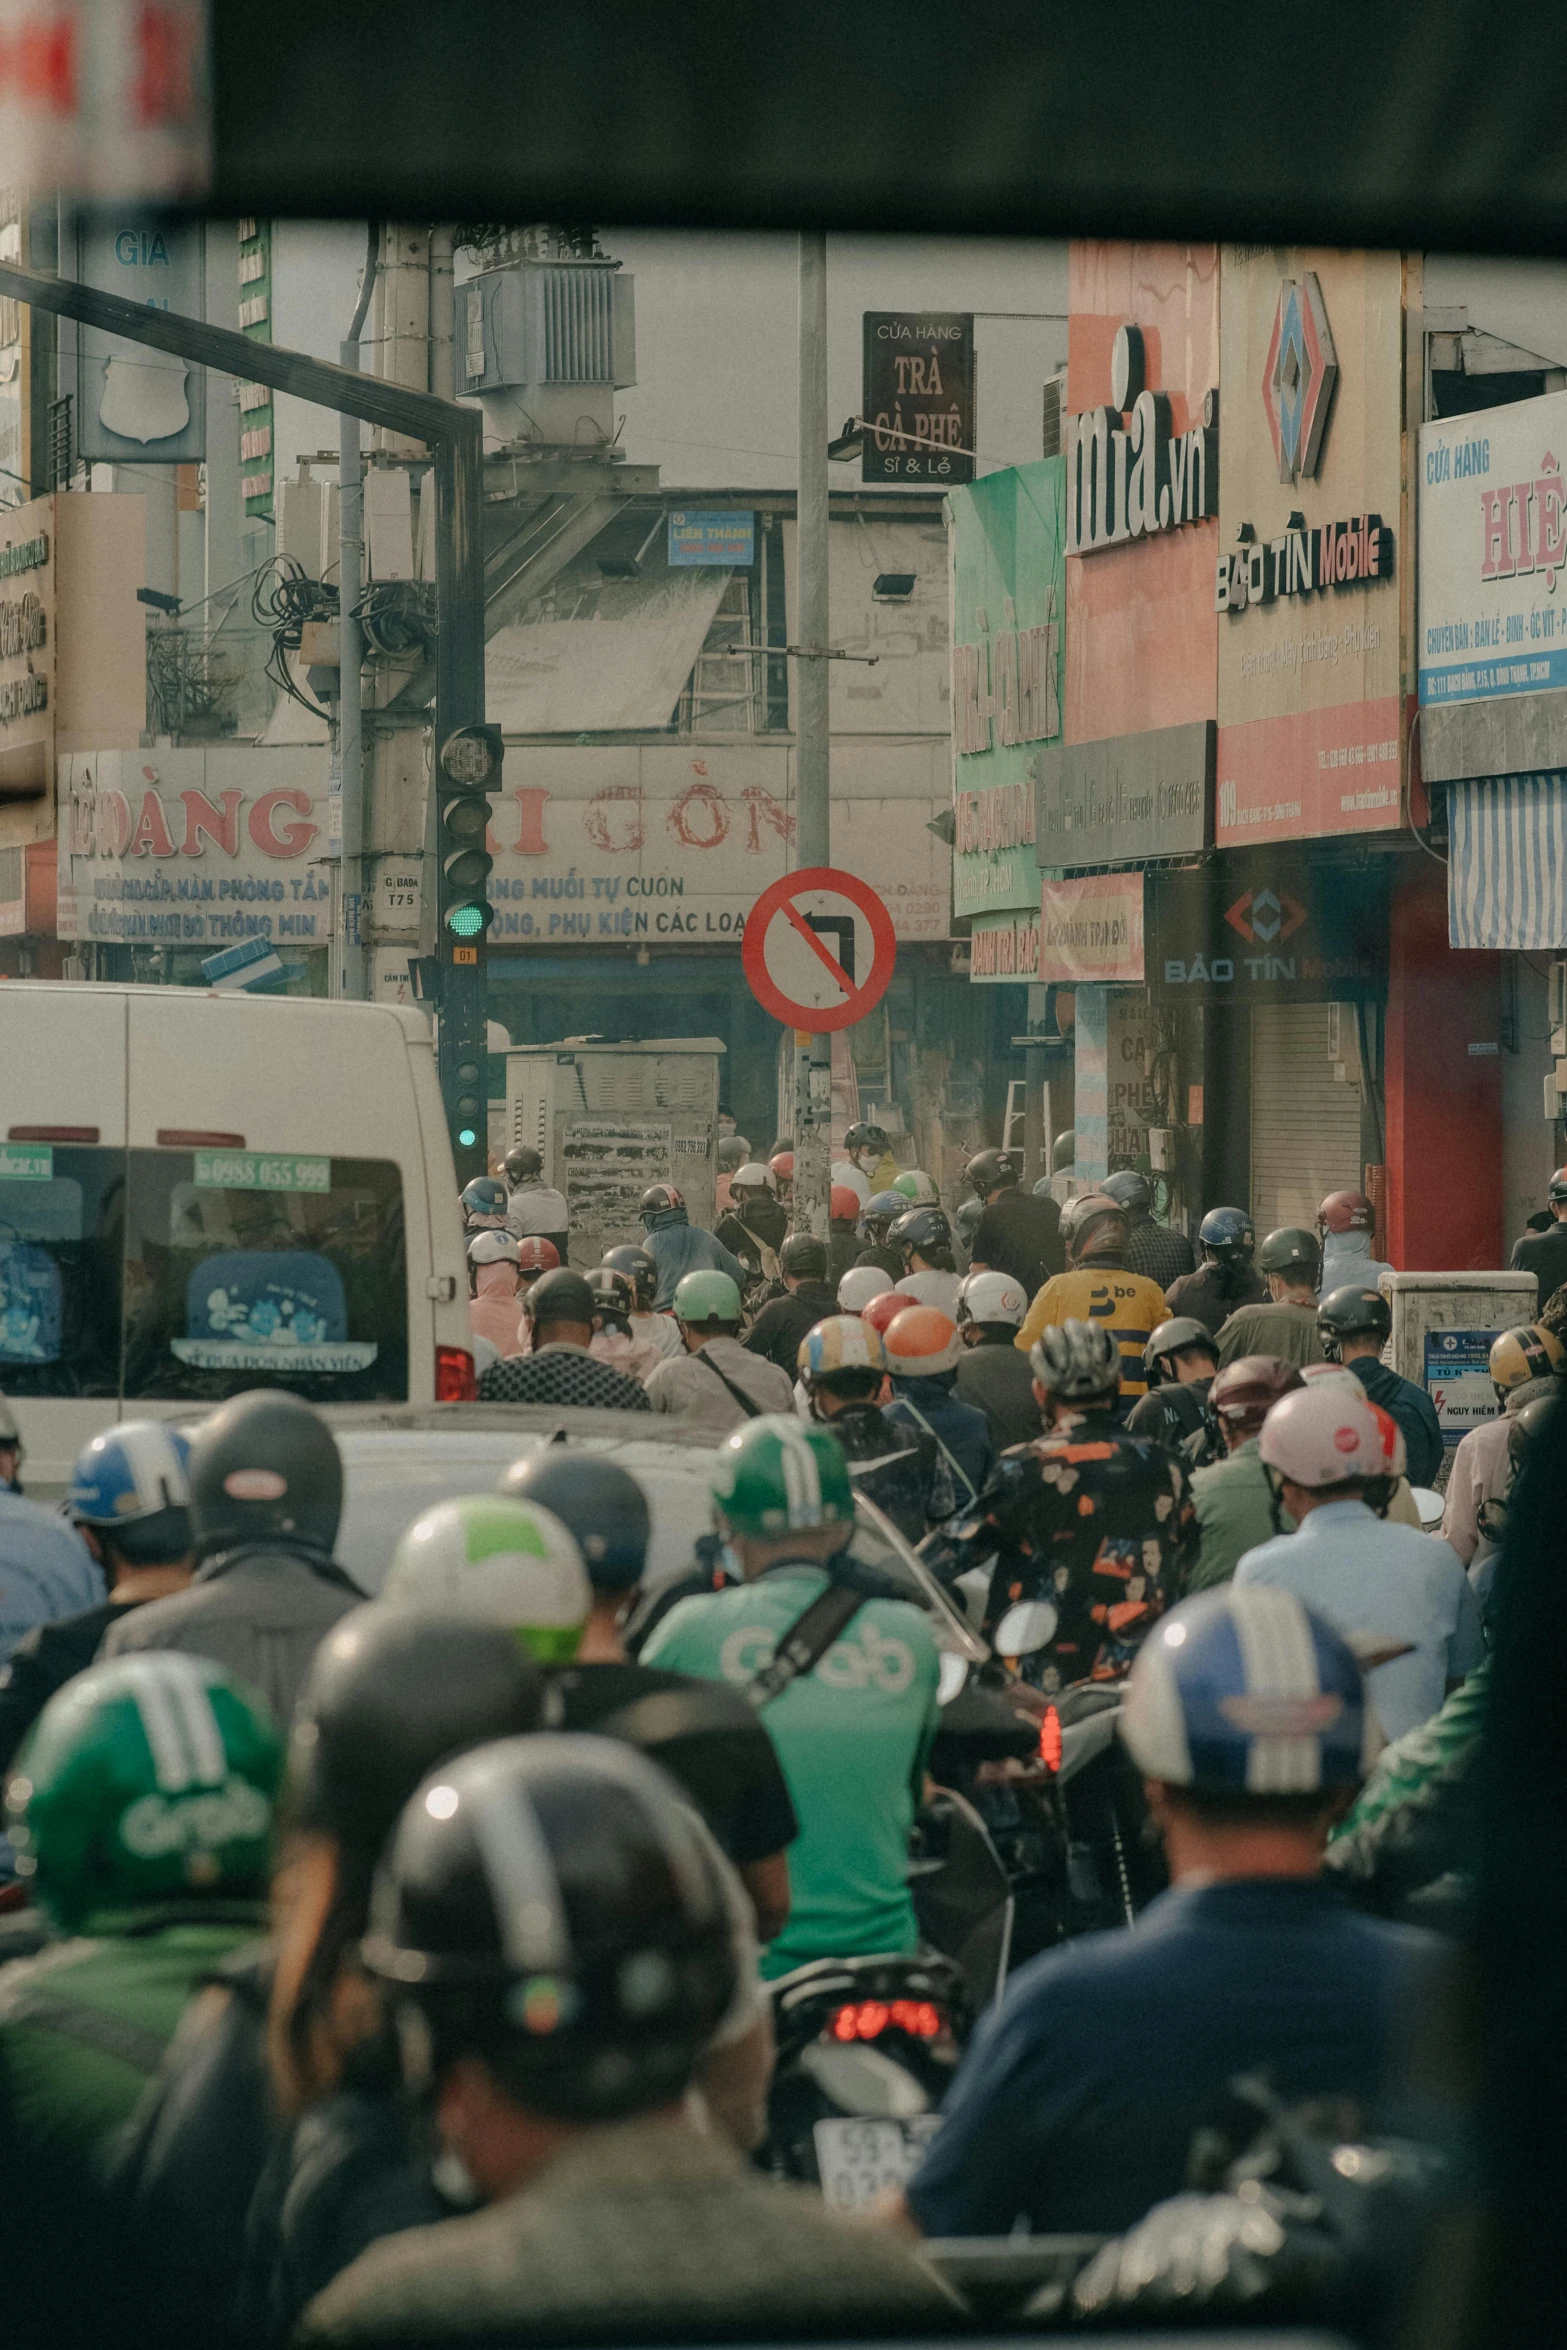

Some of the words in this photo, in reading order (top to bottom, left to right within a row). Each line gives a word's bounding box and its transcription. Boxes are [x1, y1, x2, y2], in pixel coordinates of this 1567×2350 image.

[115, 229, 171, 269] GIA
[877, 320, 911, 340] CỬA
[916, 320, 962, 340] HÀNG
[894, 345, 944, 395] TRÀ
[875, 401, 904, 451] CÀ
[914, 402, 962, 451] PHÊ
[1427, 438, 1451, 486] CỬA
[1453, 435, 1490, 479] HÀNG
[1215, 523, 1266, 613] BẢO
[1270, 511, 1314, 598] TÍN
[1319, 514, 1381, 587] Mobile
[95, 766, 320, 858] HOÀNG
[1219, 780, 1236, 828] 109
[219, 873, 284, 901] PHÒNG
[592, 875, 620, 903] TỰ
[208, 909, 272, 937] THÔNG
[548, 912, 591, 938] PHỤ
[599, 906, 648, 938] KIỆN
[656, 906, 698, 933] CÁC
[460, 950, 471, 962] 01
[1164, 953, 1234, 984] BẢO
[1243, 952, 1296, 981] TÍN
[1120, 1030, 1146, 1063] CÀ
[1113, 1284, 1136, 1298] be
[1447, 1407, 1470, 1415] NGUY
[1472, 1405, 1495, 1415] HIỂM
[719, 1623, 915, 1693] Gab
